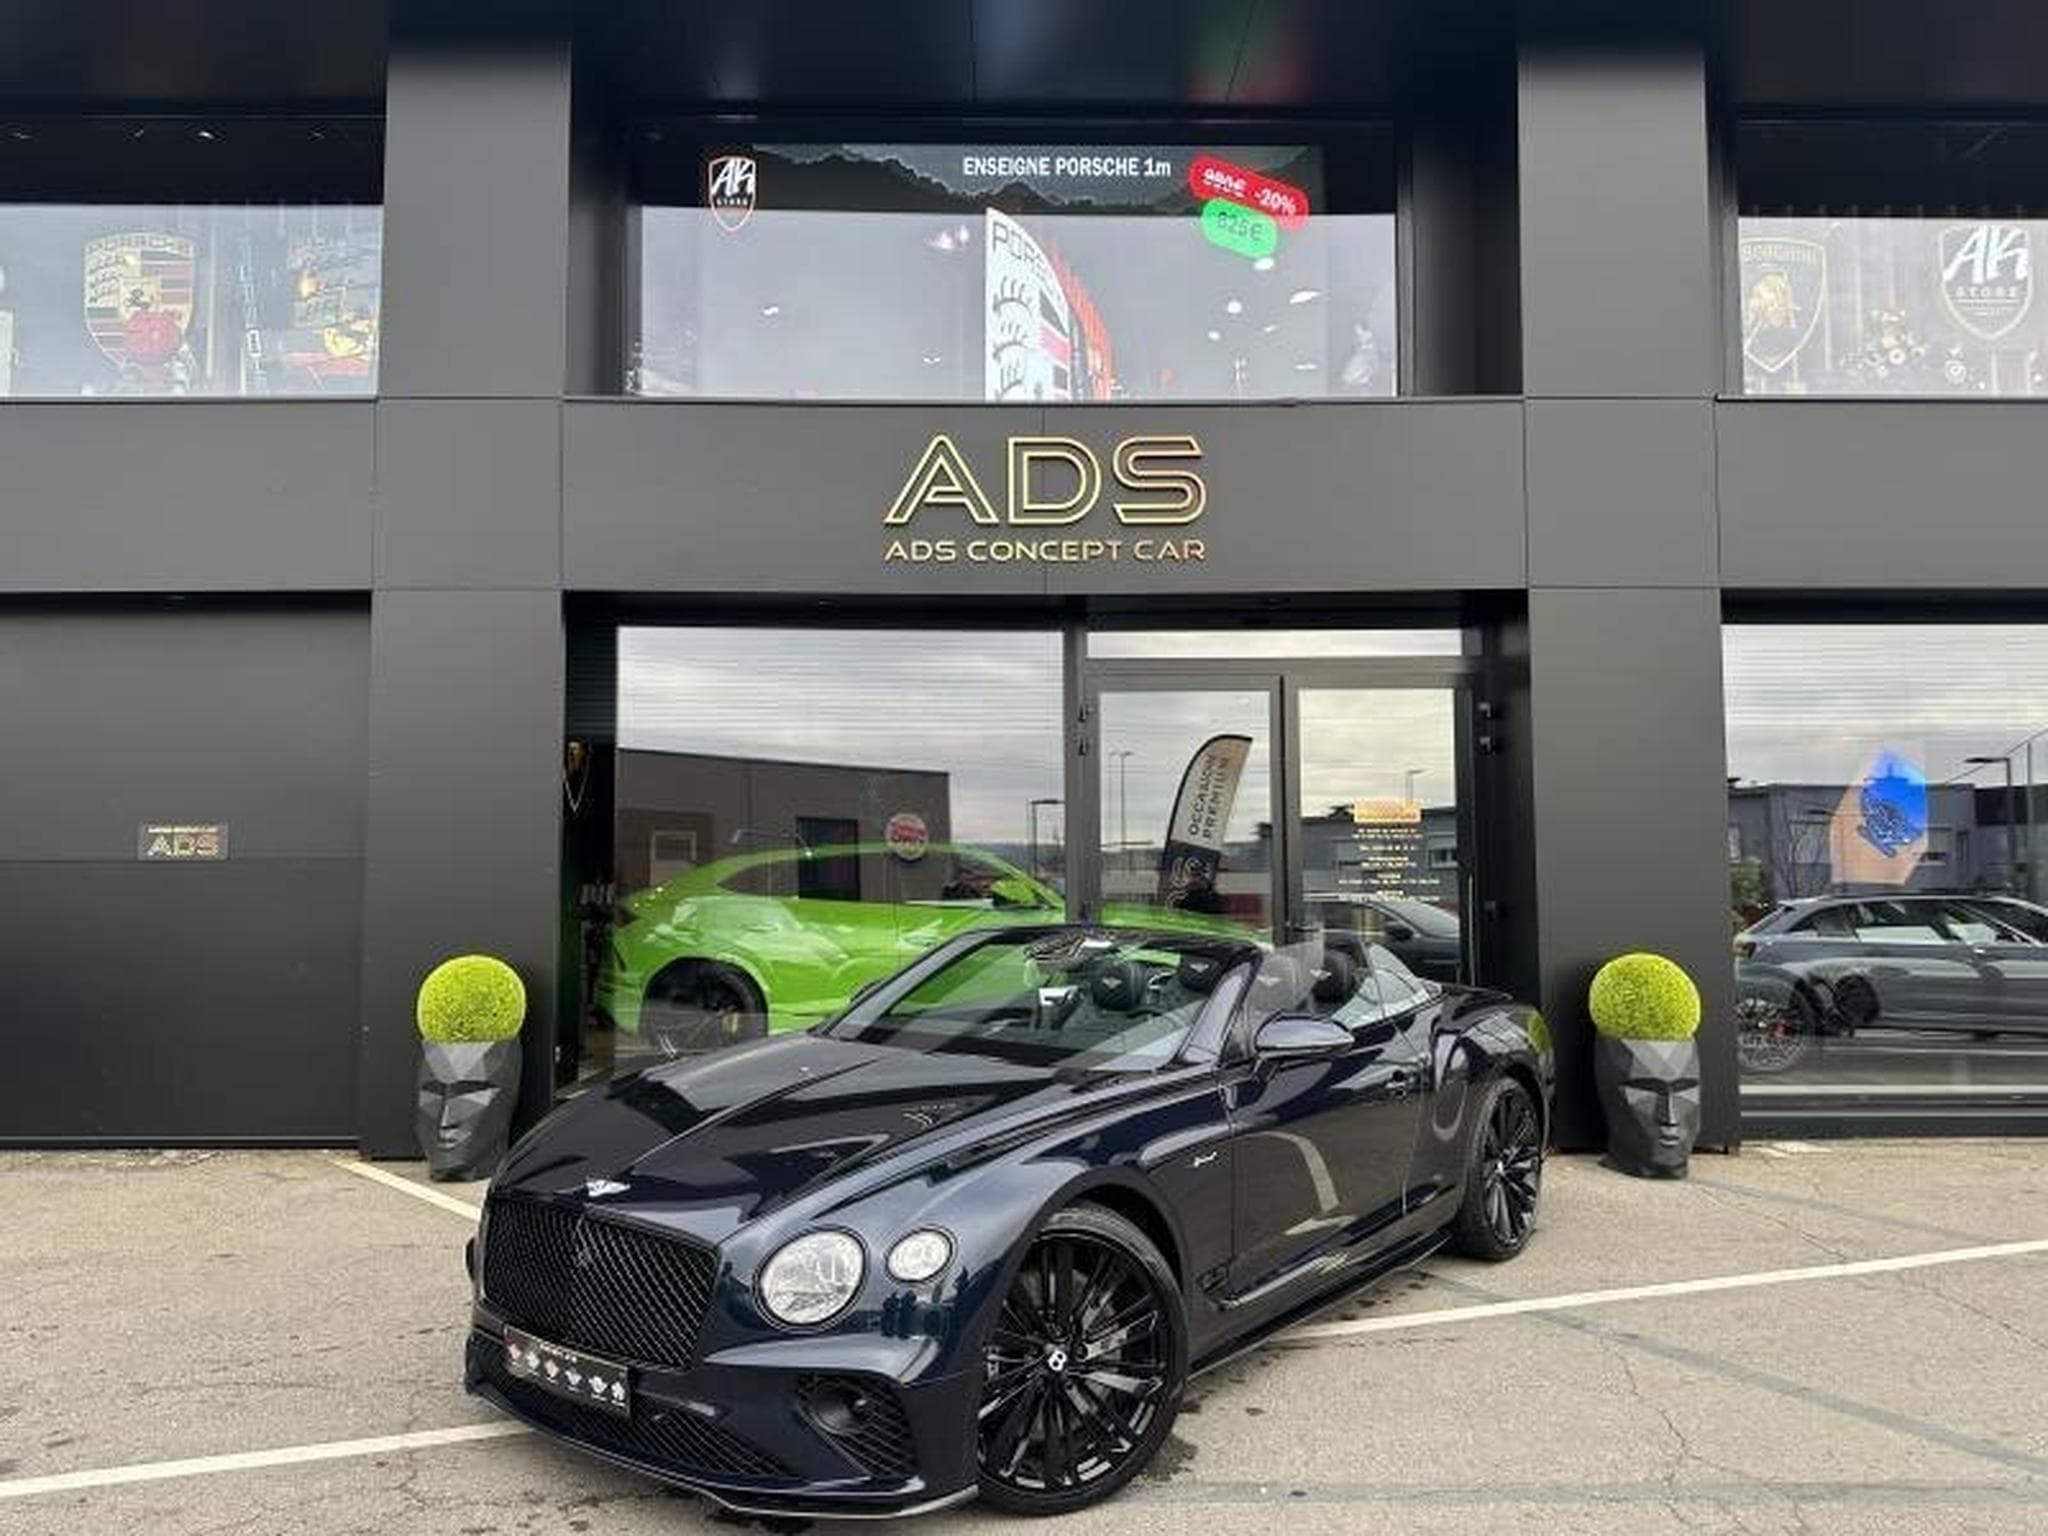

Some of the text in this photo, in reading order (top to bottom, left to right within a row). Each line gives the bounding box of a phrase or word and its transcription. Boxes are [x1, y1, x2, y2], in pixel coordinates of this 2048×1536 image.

[963, 156, 1172, 177] ENSEIGNE PORSCHE 1m
[1253, 187, 1297, 214] -20%
[884, 434, 1208, 525] ADS
[884, 540, 1206, 562] ADS CONCEPT CAR
